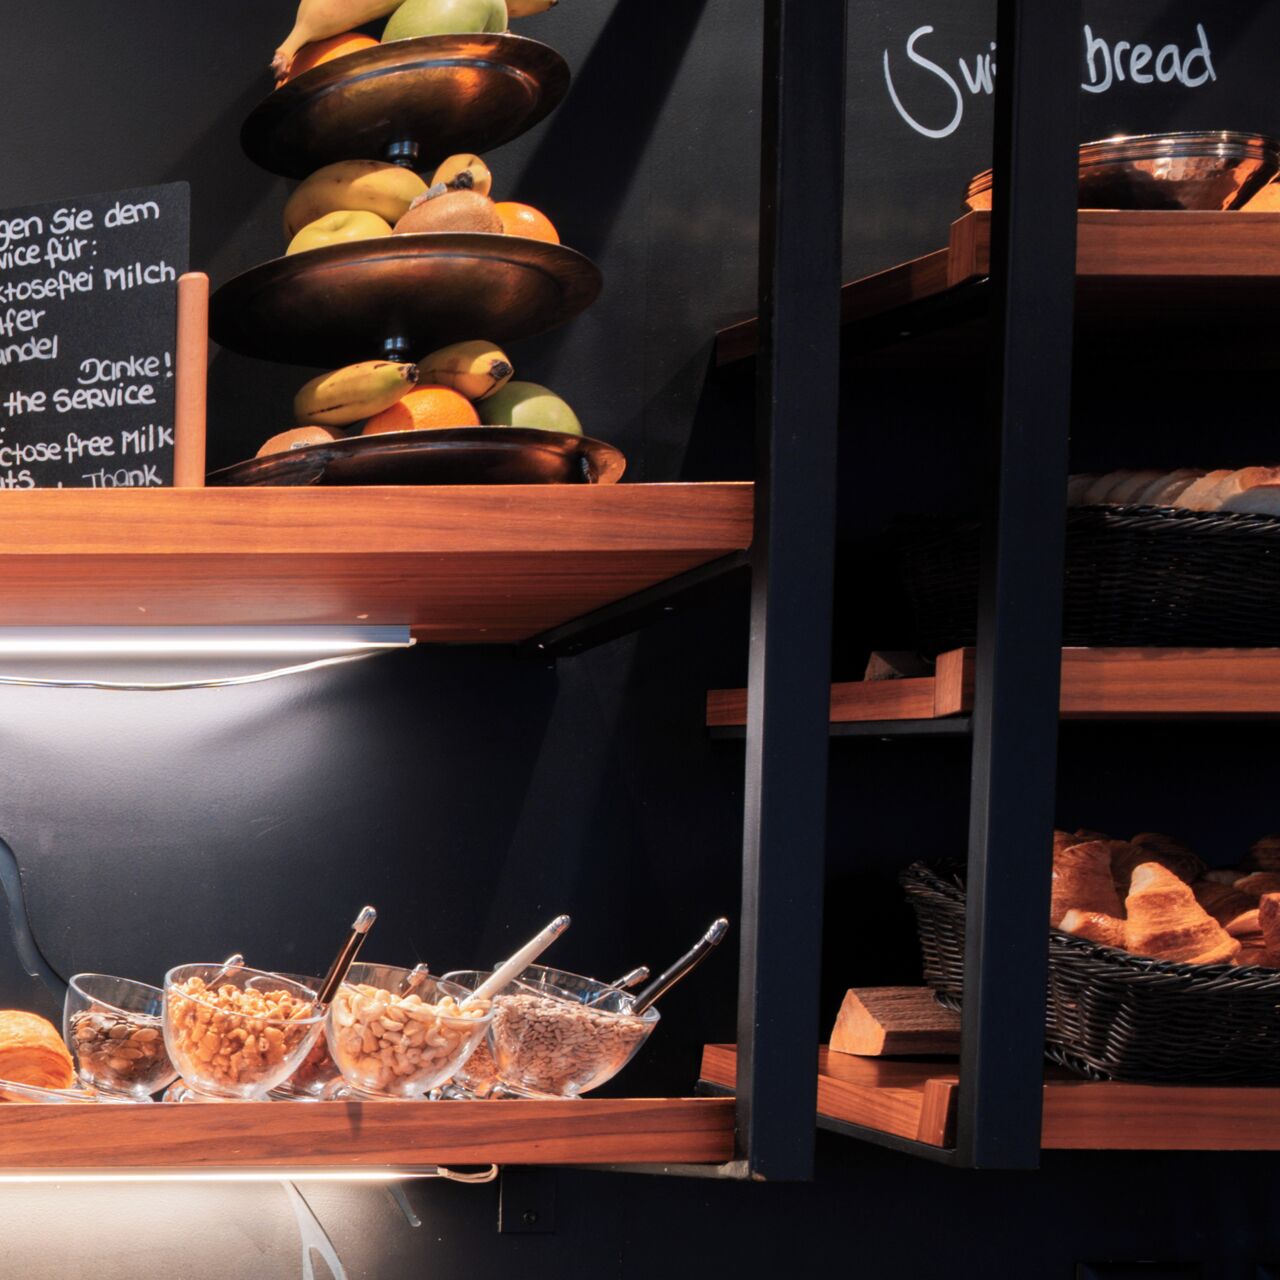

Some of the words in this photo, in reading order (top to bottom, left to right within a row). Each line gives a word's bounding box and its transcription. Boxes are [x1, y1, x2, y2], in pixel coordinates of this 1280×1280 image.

[1081, 24, 1217, 93] bread
[49, 207, 94, 235] Sie
[104, 201, 160, 228] dem
[103, 260, 177, 292] Milch
[77, 351, 175, 385] Danke!
[3, 389, 47, 417] the
[64, 432, 117, 464] free
